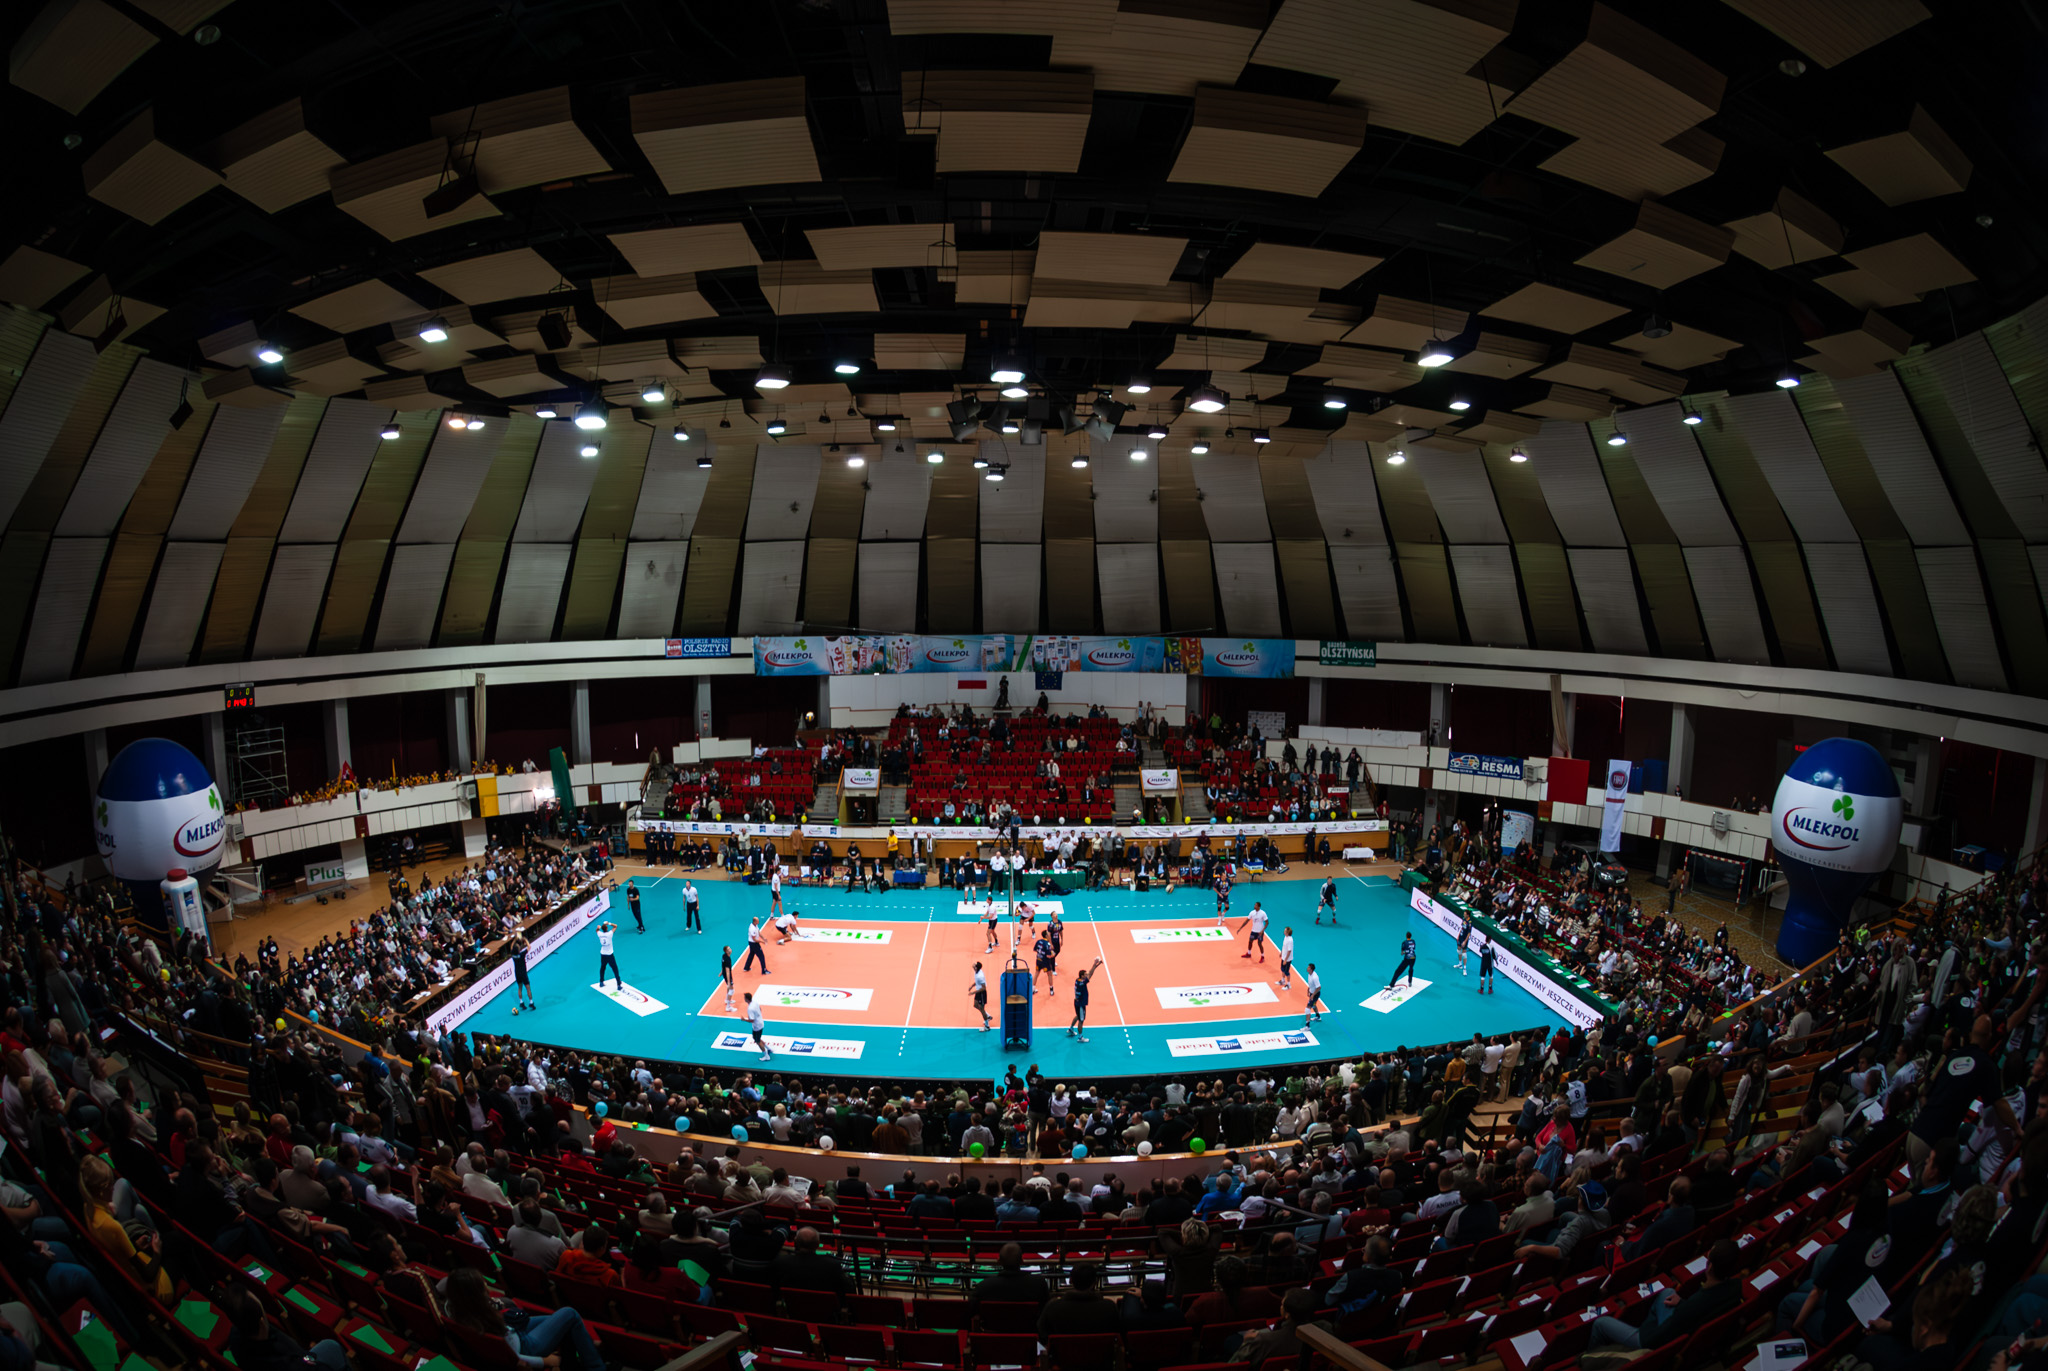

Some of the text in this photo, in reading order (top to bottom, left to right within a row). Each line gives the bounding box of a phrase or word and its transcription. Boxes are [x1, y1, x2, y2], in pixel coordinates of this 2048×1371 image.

[683, 643, 729, 653] OLSZTYN
[1320, 646, 1375, 660] OLSZTYŃSKA
[773, 652, 813, 660] MLEKPOL
[1096, 651, 1136, 660] MLEKPOL
[1223, 652, 1260, 661] MLEKPOL
[1481, 761, 1521, 775] RESMA
[186, 814, 226, 844] MLEKPO
[1792, 814, 1860, 842] MLEKPOL
[309, 866, 345, 882] Plus
[821, 931, 884, 940] Plus
[1158, 929, 1223, 938] Plus
[467, 982, 493, 1007] JESZCZE
[492, 967, 513, 987] WYŻEJ
[1177, 989, 1240, 998] MLEKPOL
[1512, 965, 1595, 1028] MIERZYMY JESZCZE WYŻE
[1574, 1089, 1581, 1099] 8
